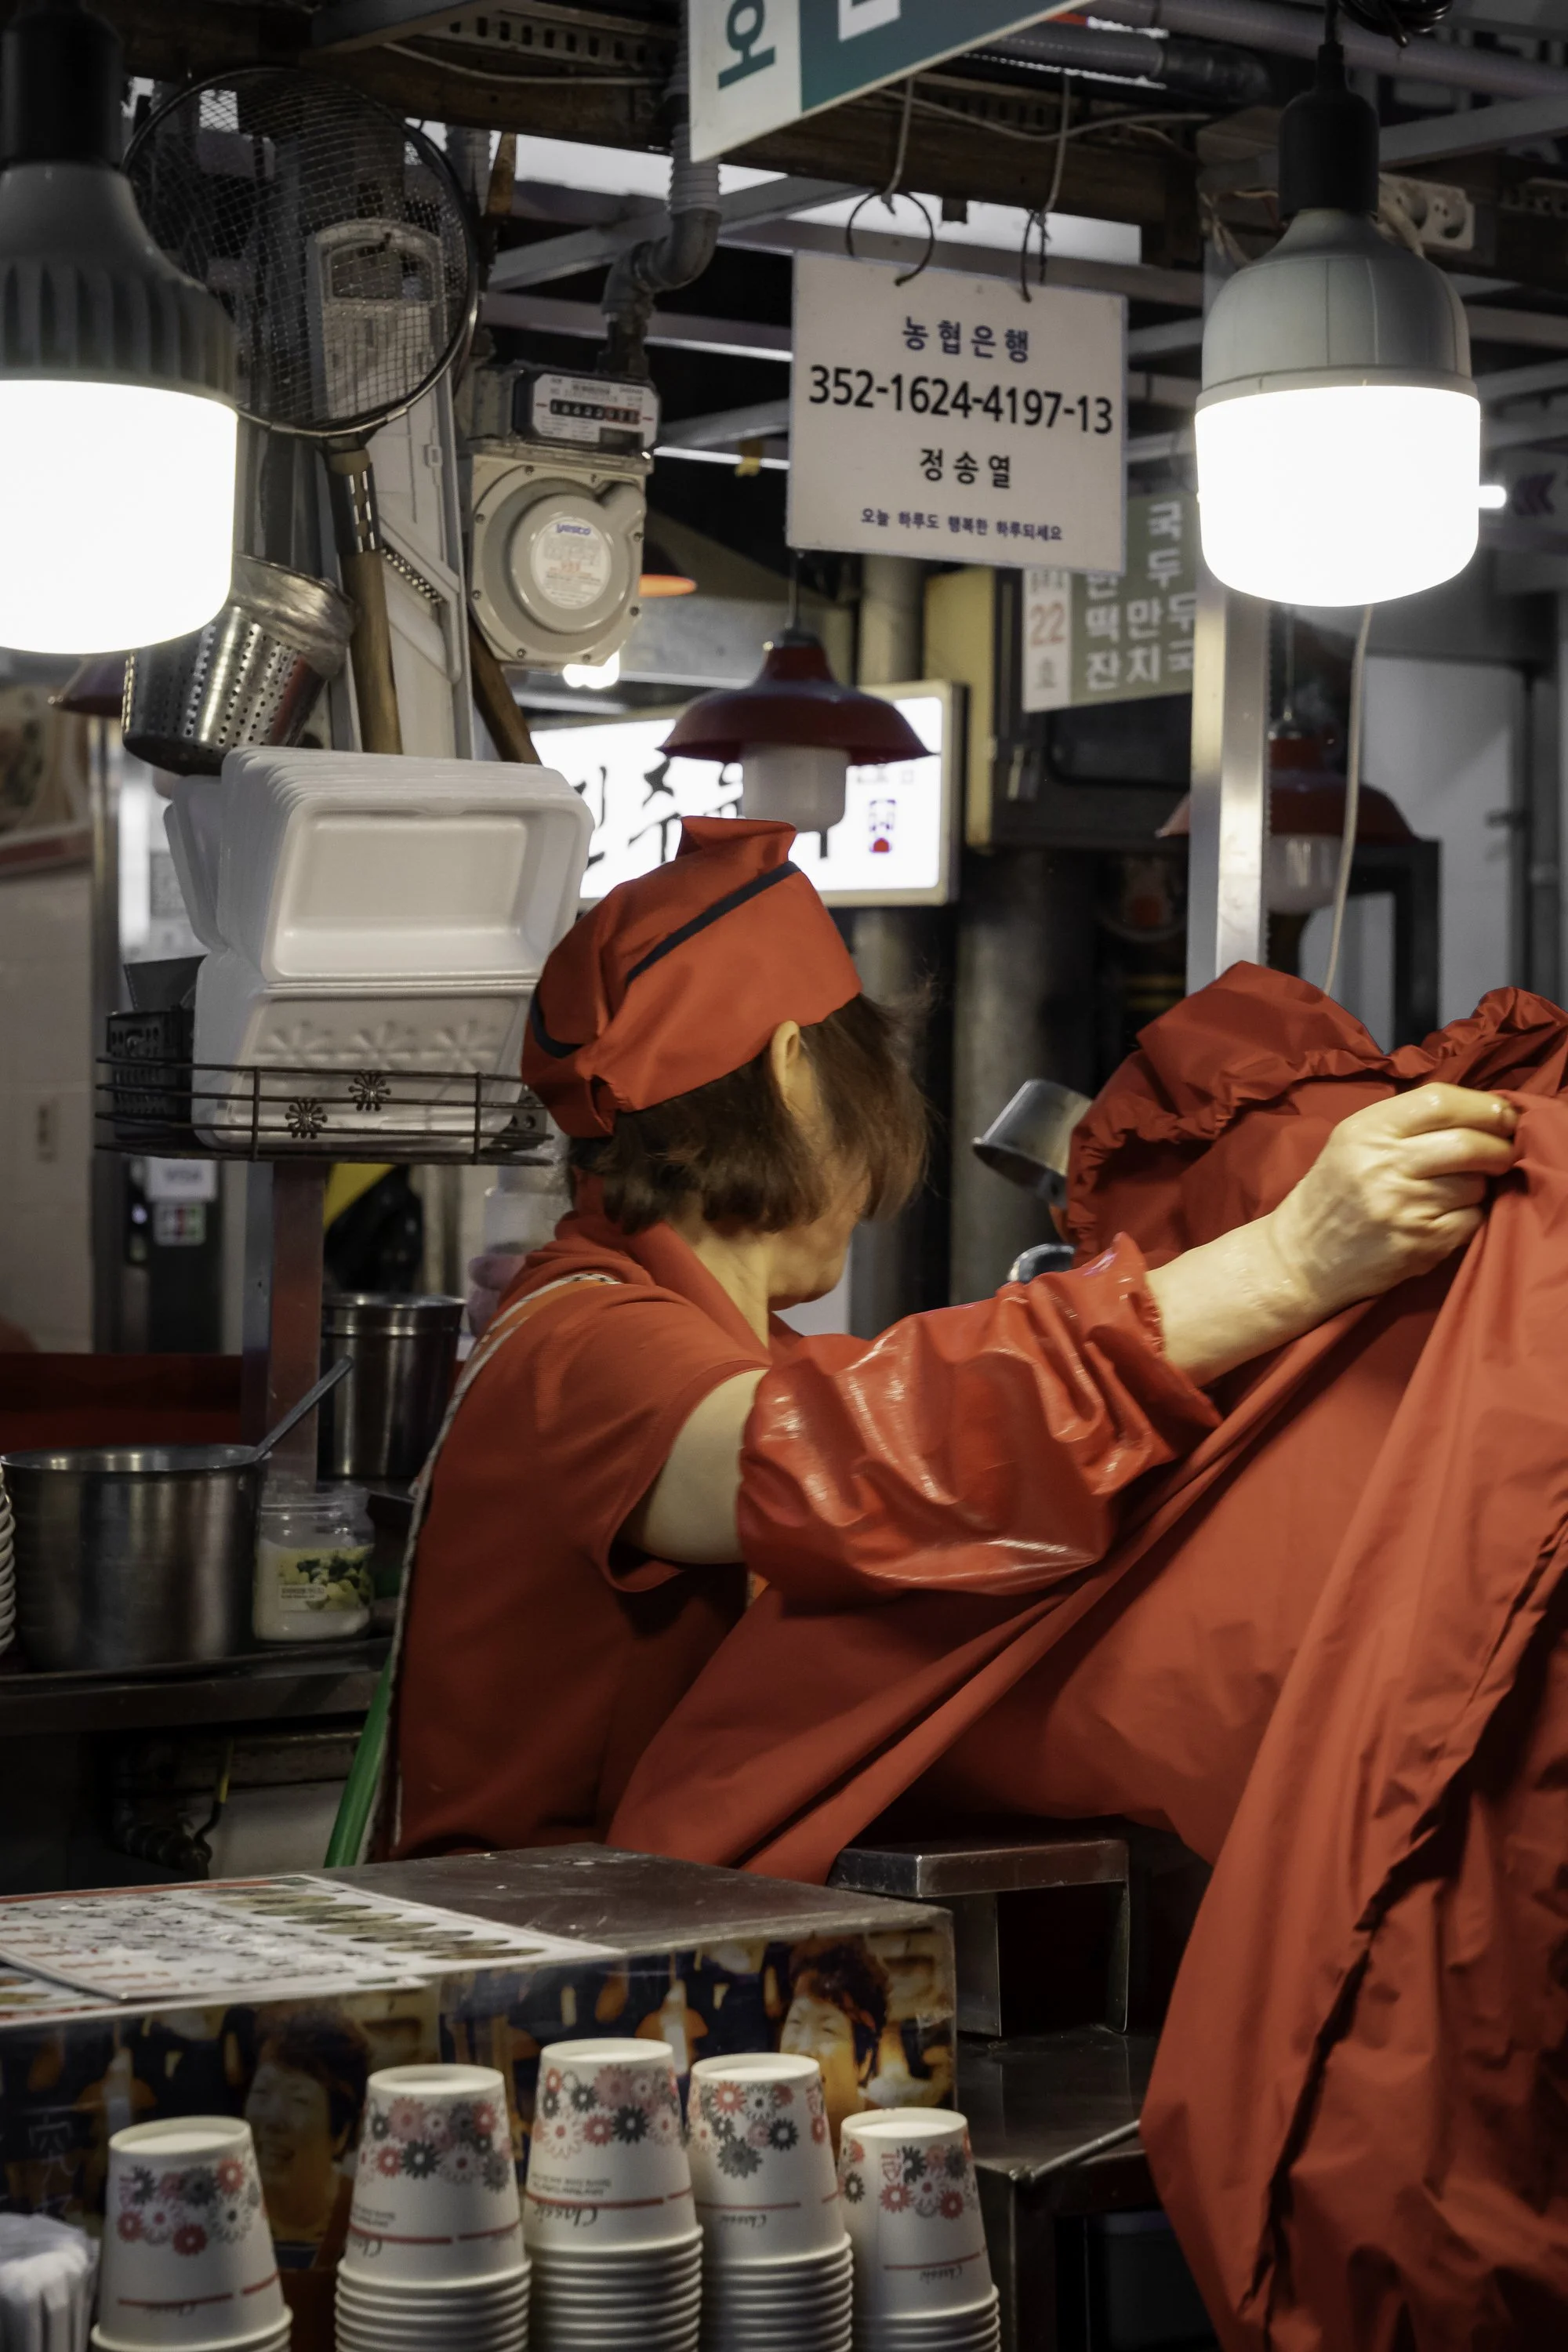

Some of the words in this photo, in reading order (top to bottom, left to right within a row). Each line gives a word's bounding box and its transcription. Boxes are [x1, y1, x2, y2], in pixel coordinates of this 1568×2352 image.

[902, 316, 1029, 364] 농협은행
[808, 364, 1114, 435] 352-1624-4197-13
[920, 448, 1011, 490] 정송열
[861, 508, 889, 527] 오늘
[898, 512, 939, 529] 하루도
[948, 516, 988, 535] 행복한
[996, 521, 1062, 541] 하루되세요
[1030, 601, 1065, 647] 22
